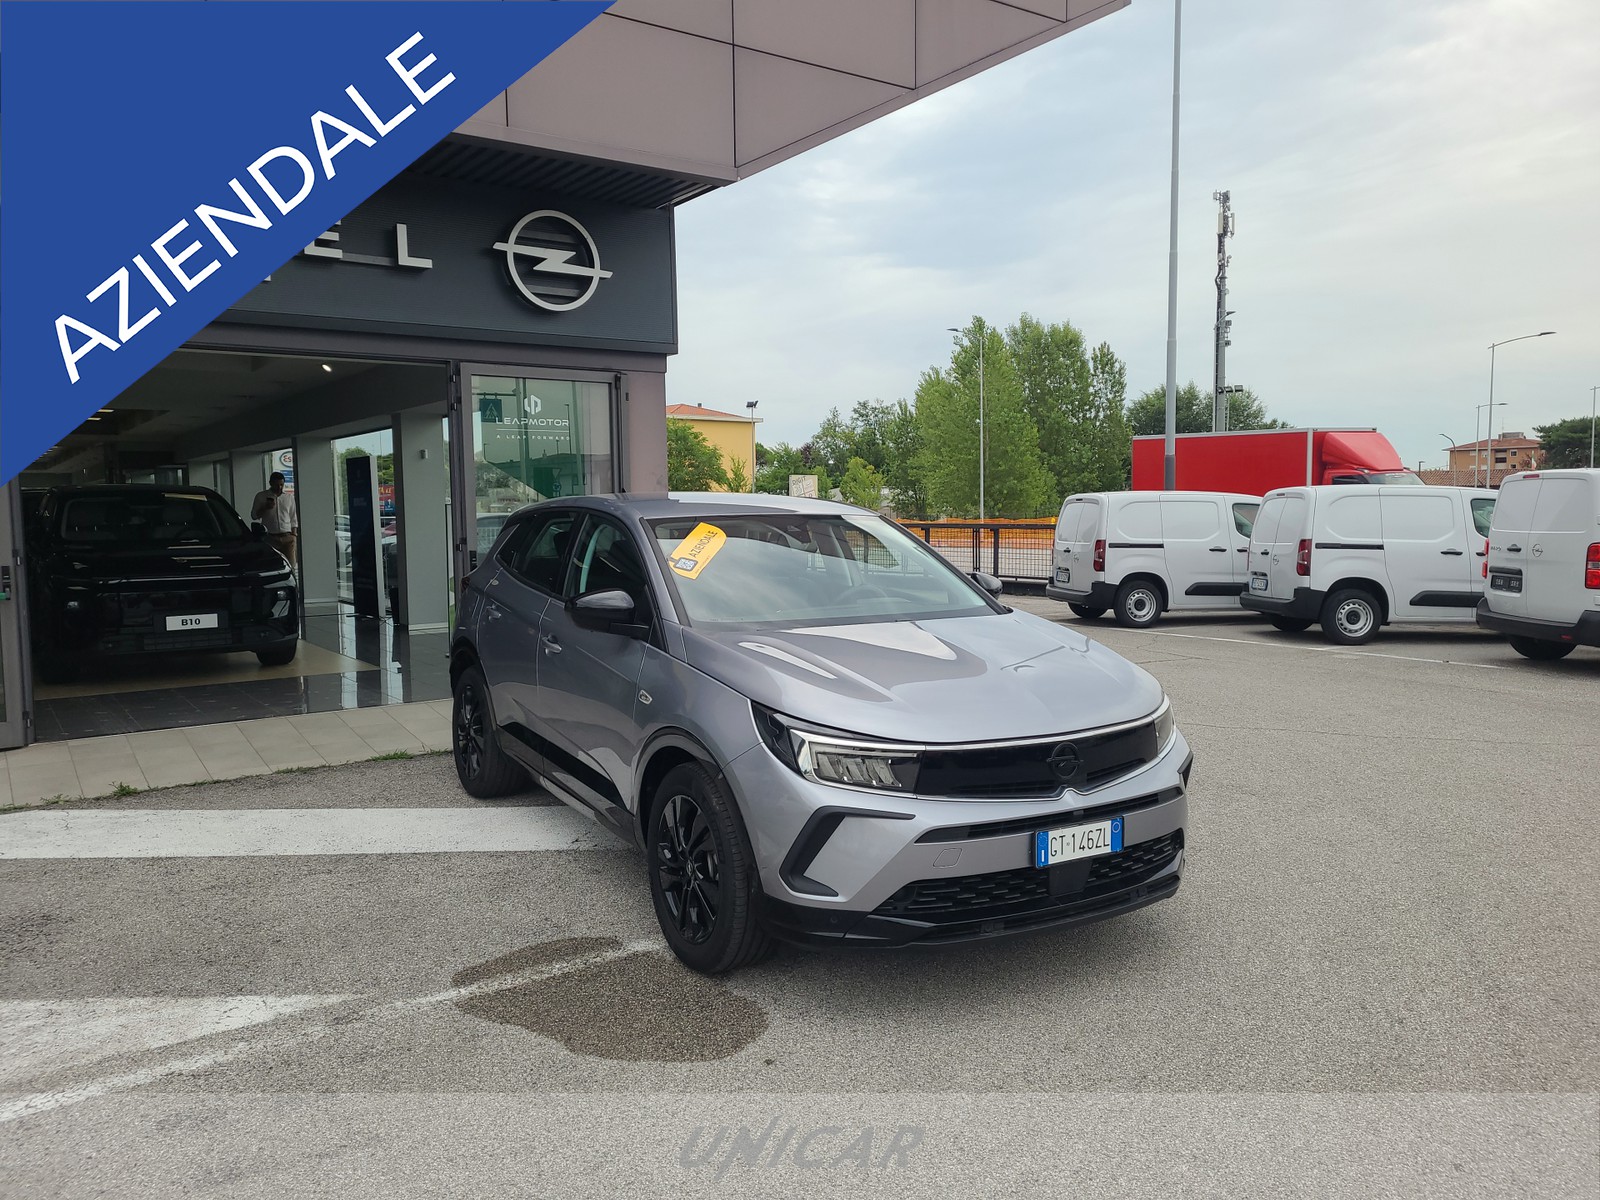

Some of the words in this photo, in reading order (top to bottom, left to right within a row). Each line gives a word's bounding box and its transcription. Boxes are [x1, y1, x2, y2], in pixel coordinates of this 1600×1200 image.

[496, 417, 570, 427] LEAPMOTOR
[688, 530, 718, 558] AZIENDALE
[181, 618, 201, 626] B10
